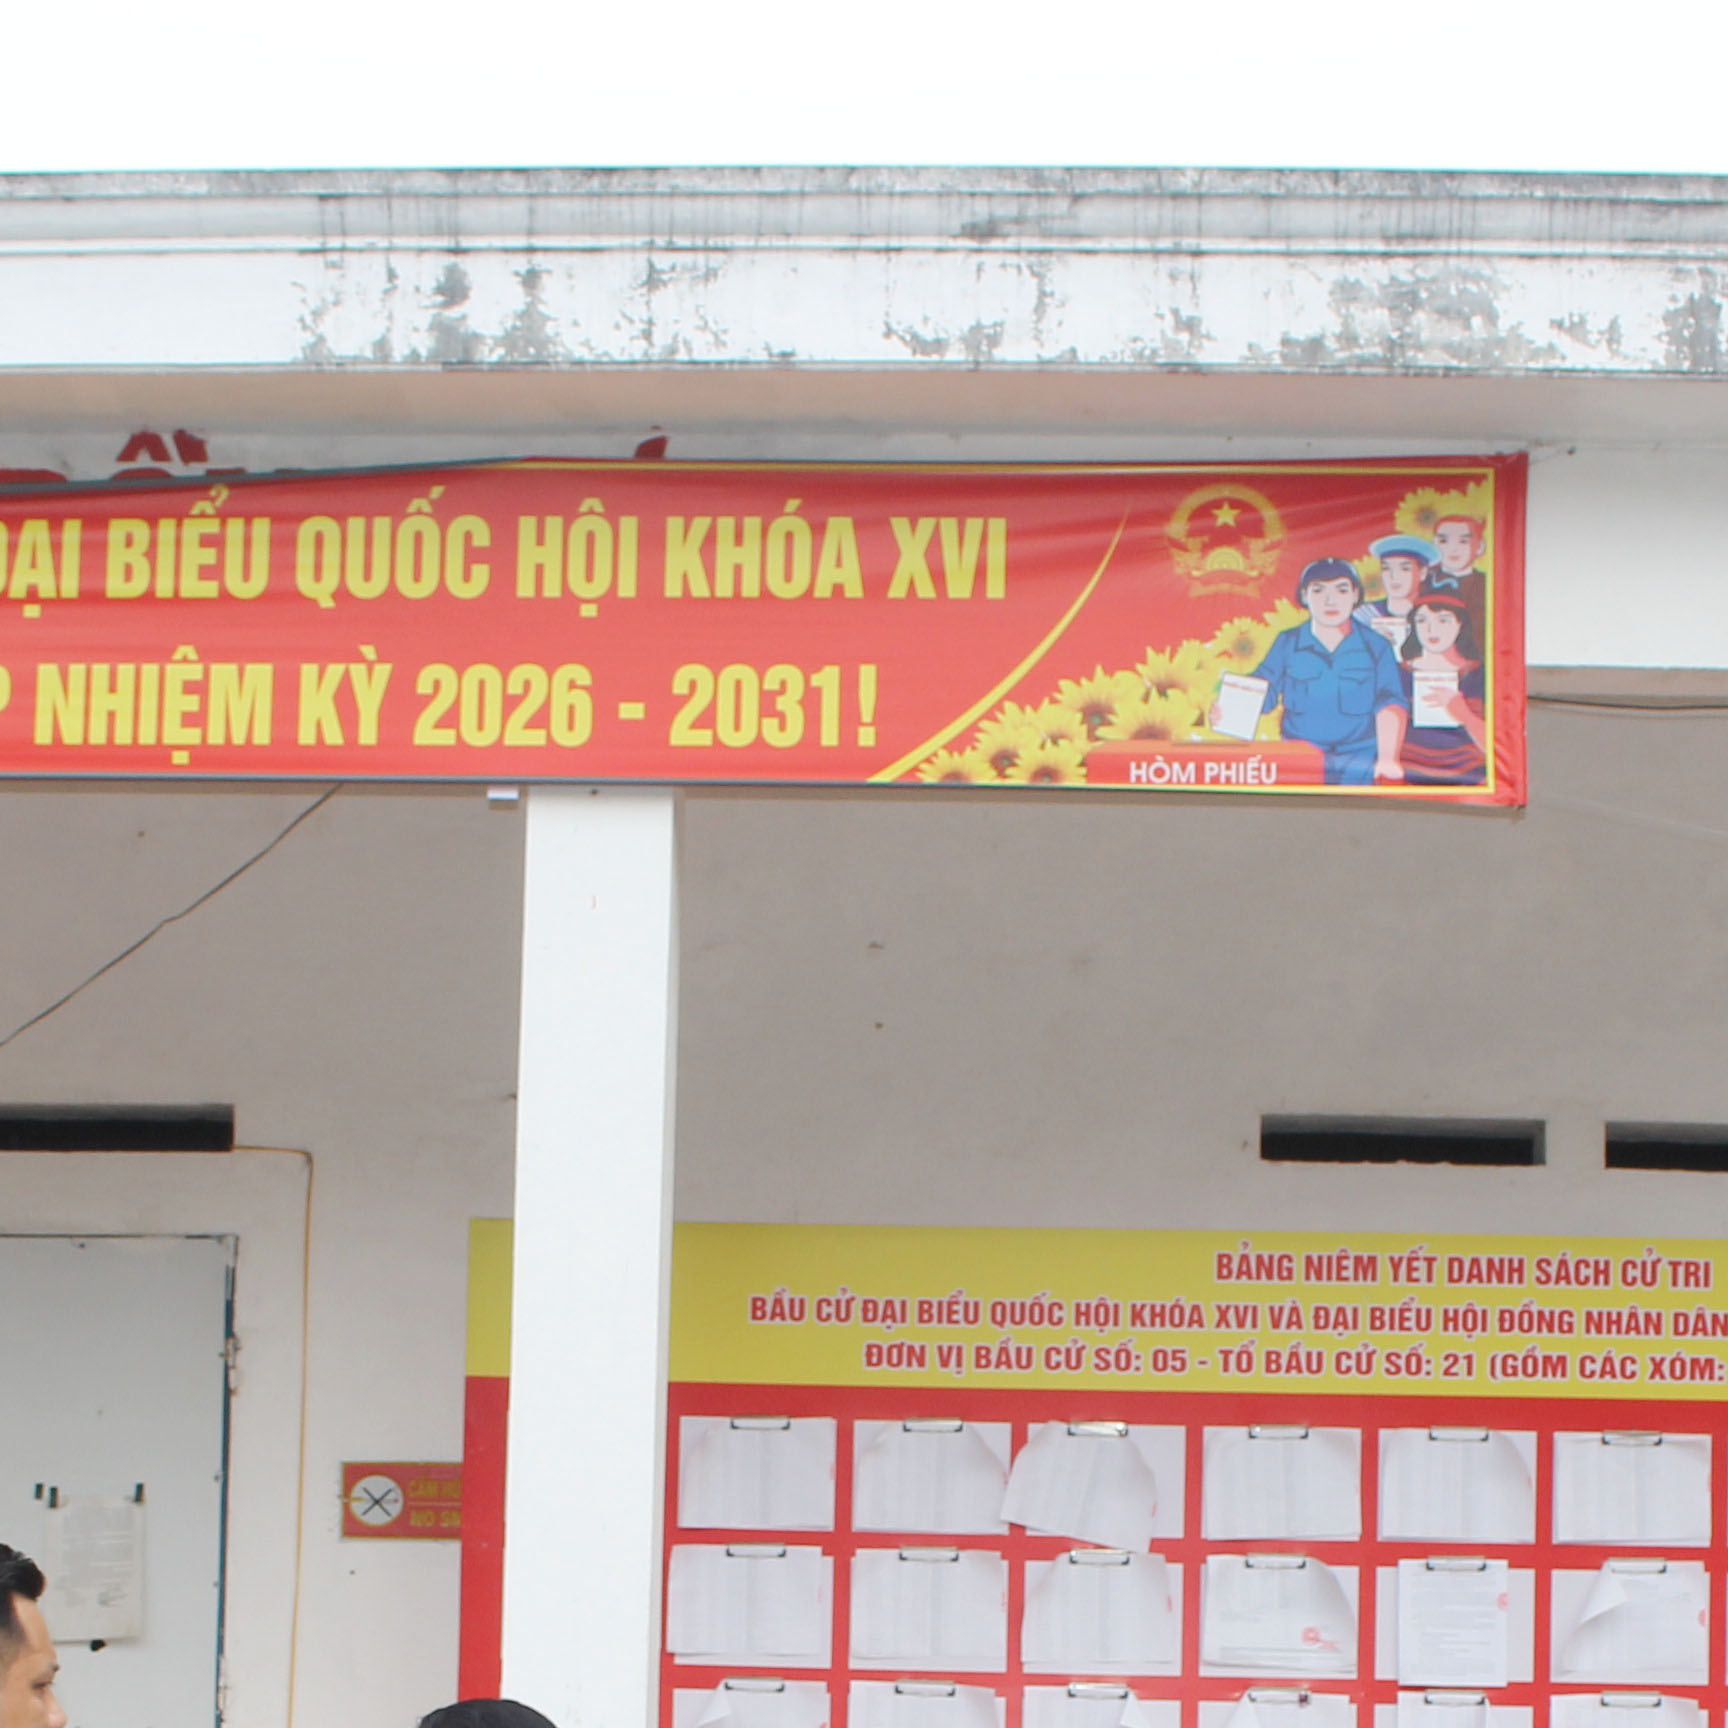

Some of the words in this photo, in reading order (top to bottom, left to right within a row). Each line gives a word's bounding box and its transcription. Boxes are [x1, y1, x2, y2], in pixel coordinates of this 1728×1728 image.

[104, 485, 271, 600] BIỂU
[294, 486, 492, 608] QUỐC
[515, 497, 638, 618] HỘI
[663, 498, 866, 600] KHÓA
[888, 516, 1008, 600] XVI
[33, 645, 273, 765] NHIỆM
[297, 645, 393, 746] KỲ
[412, 662, 594, 747] 2026
[618, 701, 646, 720] -
[671, 664, 877, 747] 2031!
[1129, 755, 1196, 783] HÒM
[1203, 755, 1278, 784] PHIẾU
[1216, 1241, 1294, 1281] BẢNG
[1304, 1248, 1378, 1283] NIÊM
[1388, 1244, 1437, 1283] YẾT
[1447, 1256, 1525, 1285] DANH
[1535, 1252, 1611, 1287] SÁCH
[1621, 1247, 1662, 1288] CỬ
[1669, 1260, 1711, 1288] TRI
[815, 1287, 855, 1323] CỬ
[861, 1298, 907, 1330] ĐẠI
[917, 1289, 980, 1325] BIỂU
[990, 1292, 1064, 1328] QUỐC
[1075, 1297, 1120, 1333] HỘI
[1130, 1298, 1205, 1329] KHÓA
[1215, 1305, 1259, 1329] XVI
[1268, 1299, 1304, 1331] VÀ
[1312, 1306, 1359, 1338] ĐẠI
[1369, 1296, 1433, 1332] BIỂU
[1442, 1303, 1488, 1339] HỘI
[1584, 1305, 1662, 1336] NHÂN
[864, 1341, 926, 1368] ĐƠN
[936, 1345, 966, 1375] VỊ
[1044, 1337, 1088, 1371] CỬ
[1093, 1338, 1142, 1373] SỐ:
[1152, 1348, 1188, 1373] 05
[1334, 1342, 1378, 1376] CỬ
[1384, 1343, 1433, 1377] SỐ:
[1442, 1352, 1476, 1378] 21
[1578, 1349, 1640, 1381] CÁC
[1648, 1350, 1726, 1383] XÓM:
